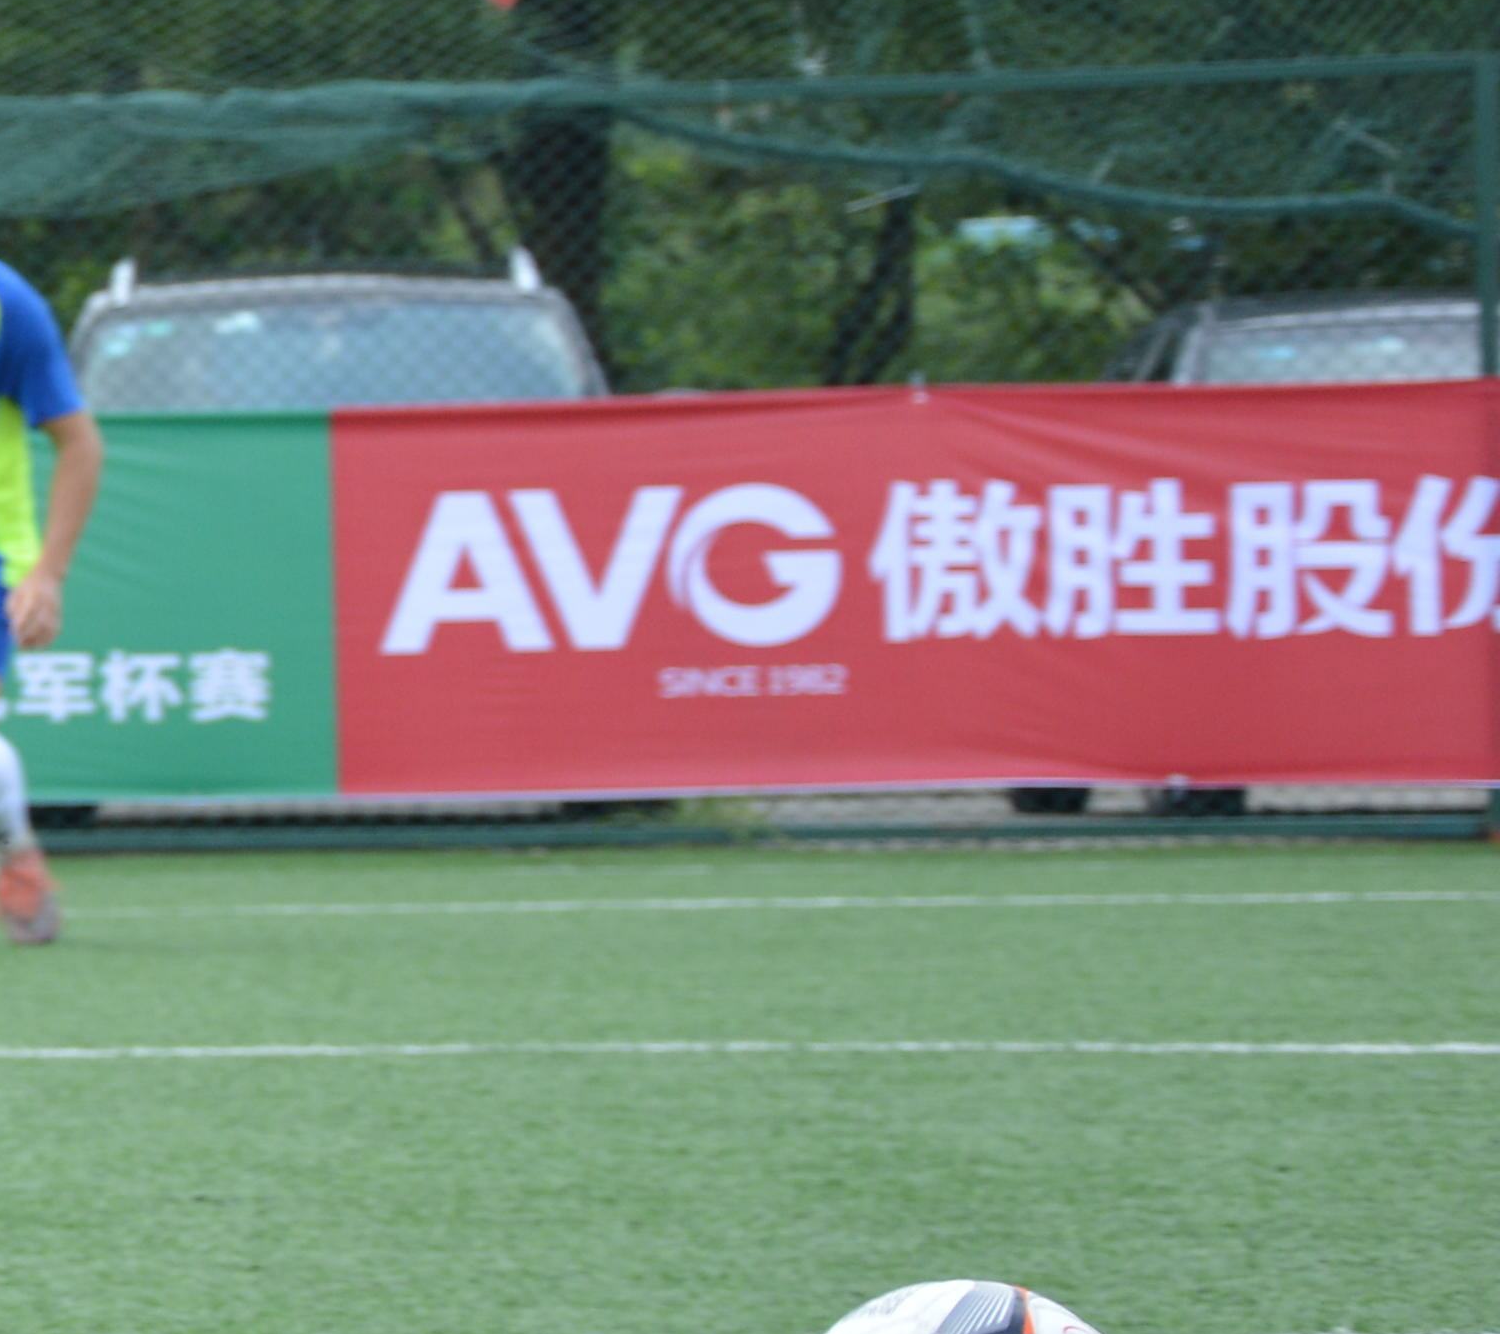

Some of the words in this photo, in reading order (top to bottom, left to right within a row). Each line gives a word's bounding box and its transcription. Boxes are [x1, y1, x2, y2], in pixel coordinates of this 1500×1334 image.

[380, 482, 842, 654] AVG
[870, 473, 1500, 642] 傲胜股份
